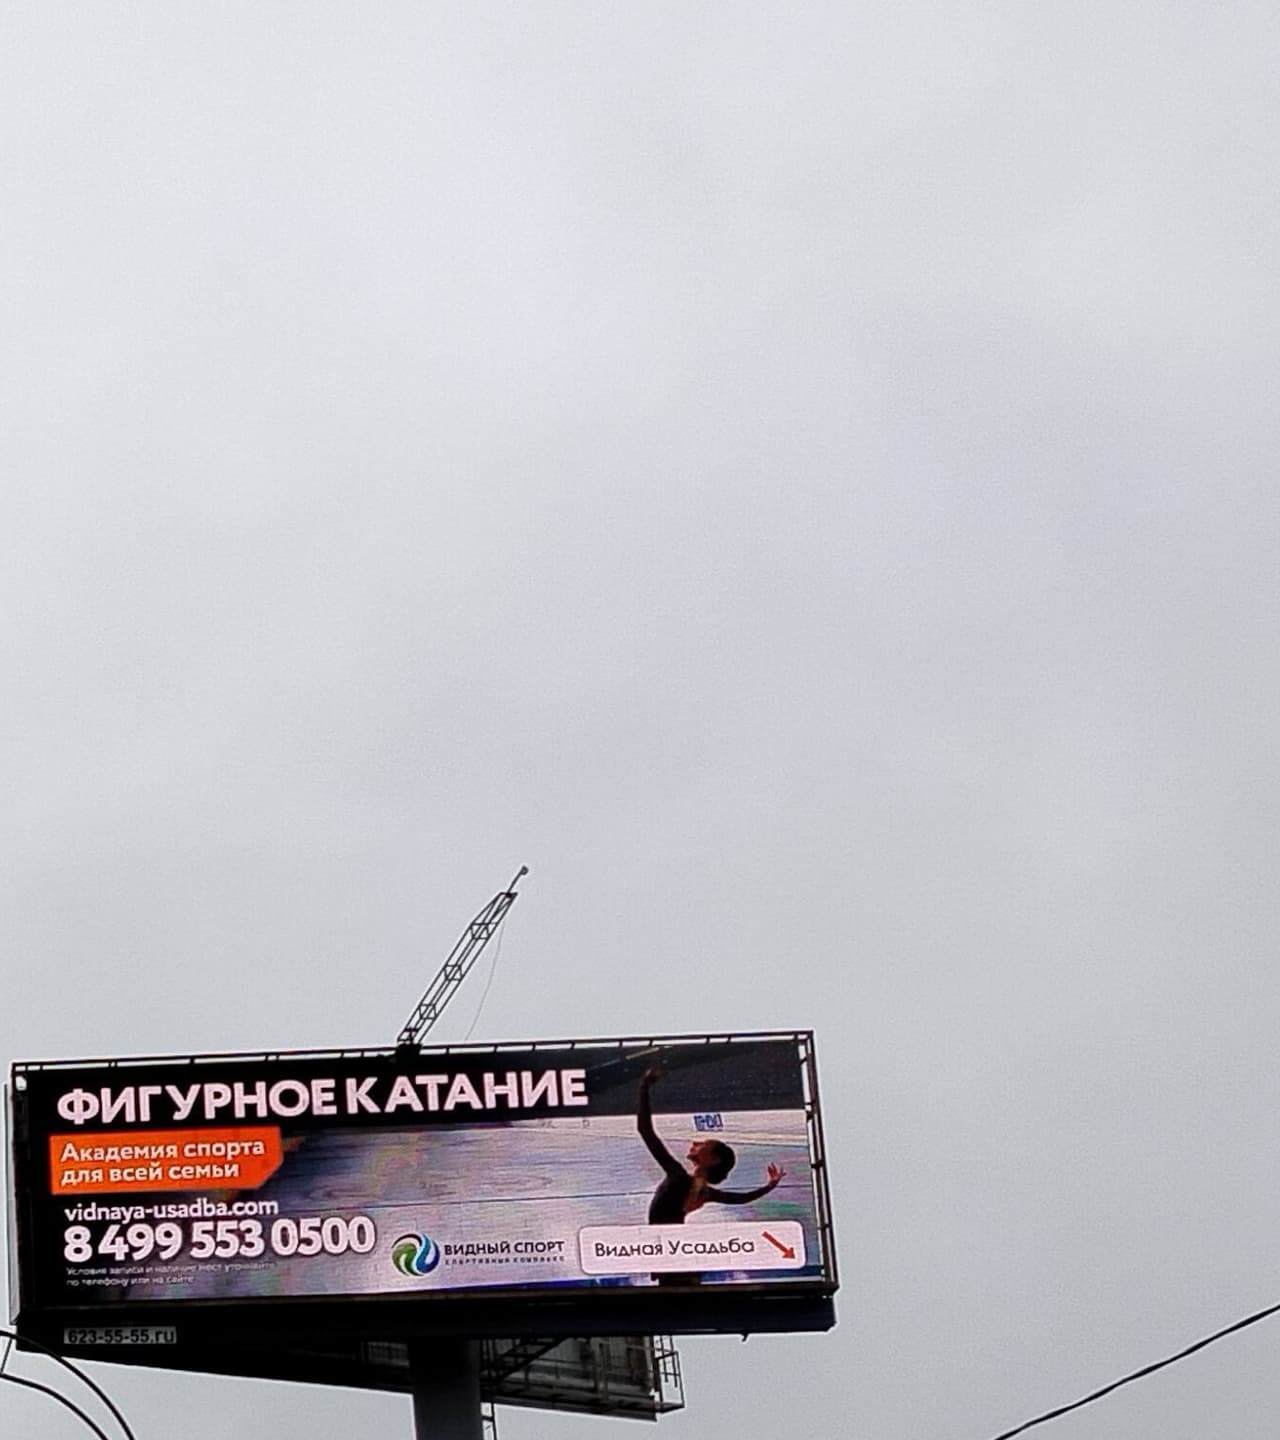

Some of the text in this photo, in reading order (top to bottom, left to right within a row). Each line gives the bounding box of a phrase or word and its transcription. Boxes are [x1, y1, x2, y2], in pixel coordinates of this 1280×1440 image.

[57, 1069, 588, 1125] ФИГУРНОЕ КАТАНИЕ
[61, 1141, 265, 1162] Академия спорта
[61, 1162, 239, 1186] для всей семьи
[64, 1198, 279, 1224] vidnaya-usadba.com
[64, 1216, 375, 1262] 8 499 553 0500
[444, 1240, 565, 1256] ВИДНЫЙ СПОРТ
[595, 1237, 755, 1257] Видная Усадьба
[68, 1327, 176, 1344] 623-55-55.ru
